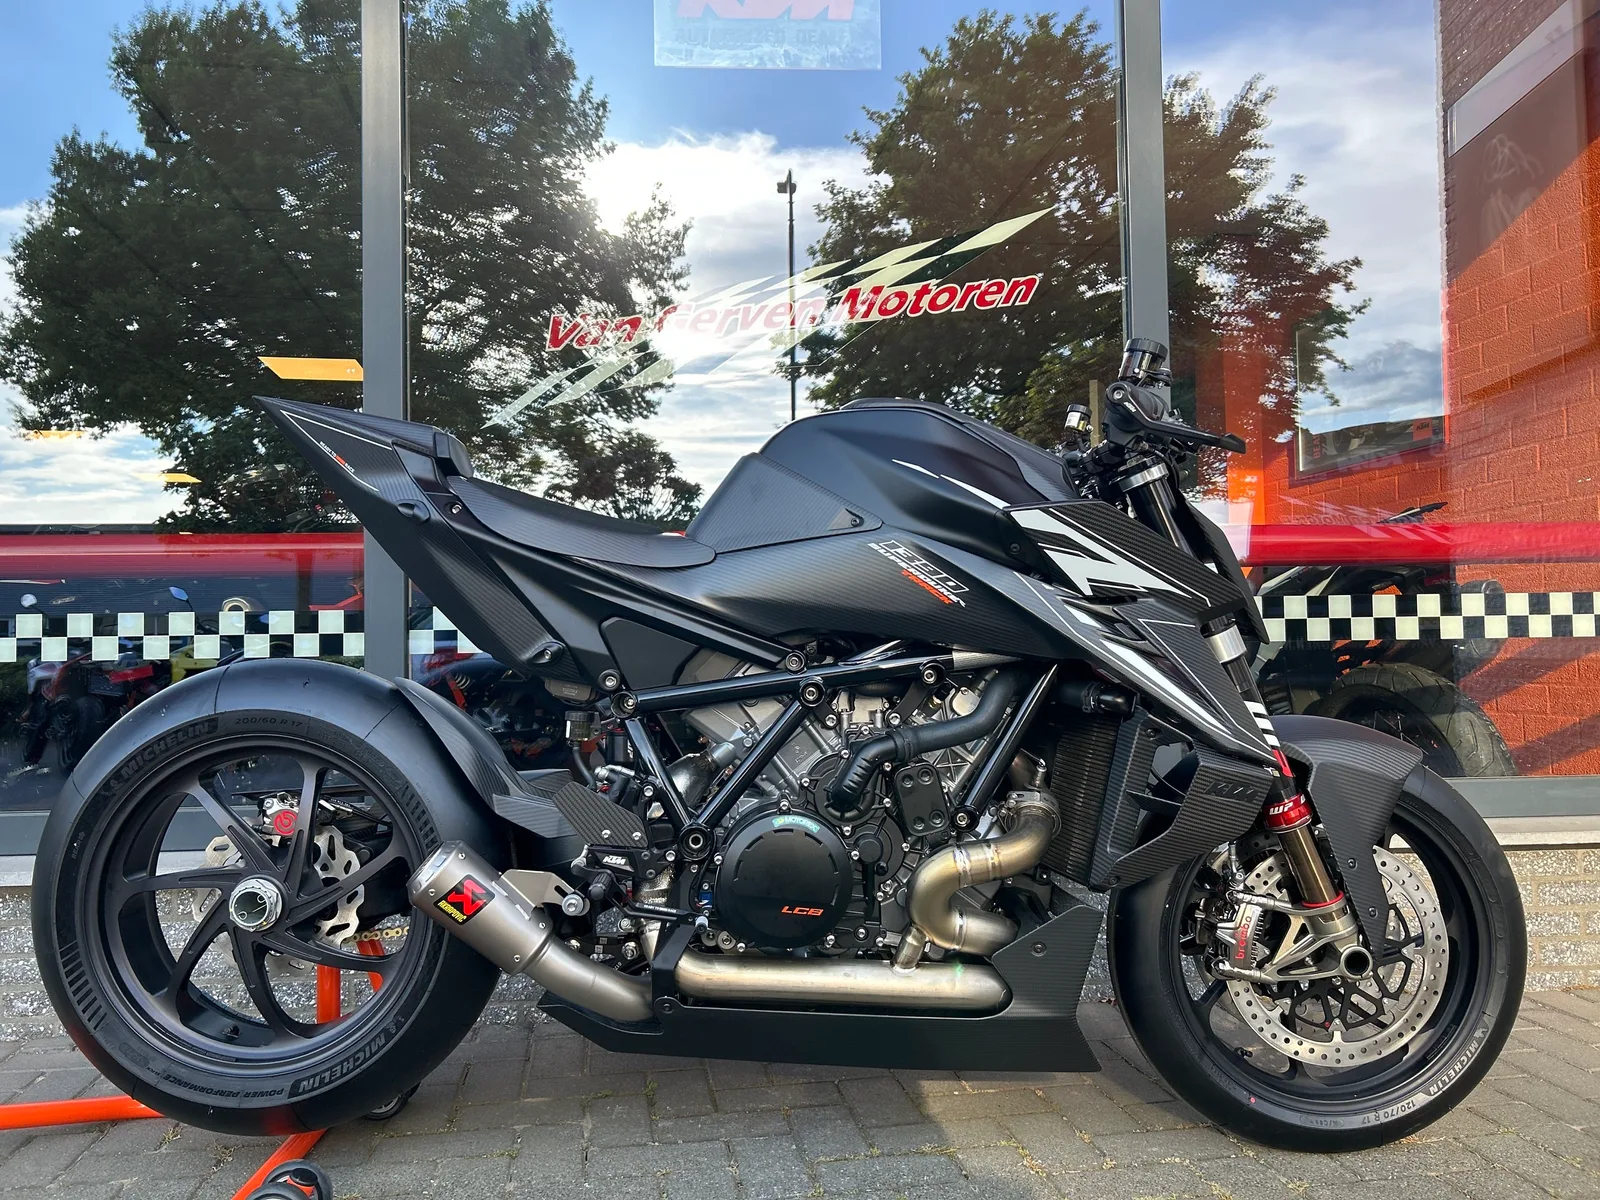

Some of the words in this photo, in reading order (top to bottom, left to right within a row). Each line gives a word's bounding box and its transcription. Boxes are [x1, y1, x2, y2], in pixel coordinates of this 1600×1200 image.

[546, 311, 644, 351] Van
[832, 275, 1043, 323] Motoren
[235, 716, 277, 725] 200/60
[291, 720, 302, 728] 17
[121, 722, 209, 779] MICHELIN
[1269, 802, 1294, 815] WP
[602, 855, 627, 865] KTM
[1235, 915, 1252, 959] brembo
[298, 1033, 386, 1093] MICHELIN
[1429, 1040, 1479, 1096] MICHELIN
[163, 1074, 241, 1098] PERFORMANCE
[244, 1087, 285, 1098] POWER
[1374, 1112, 1381, 1122] R
[1383, 1100, 1415, 1119] 120/70
[1361, 1116, 1371, 1125] 17
